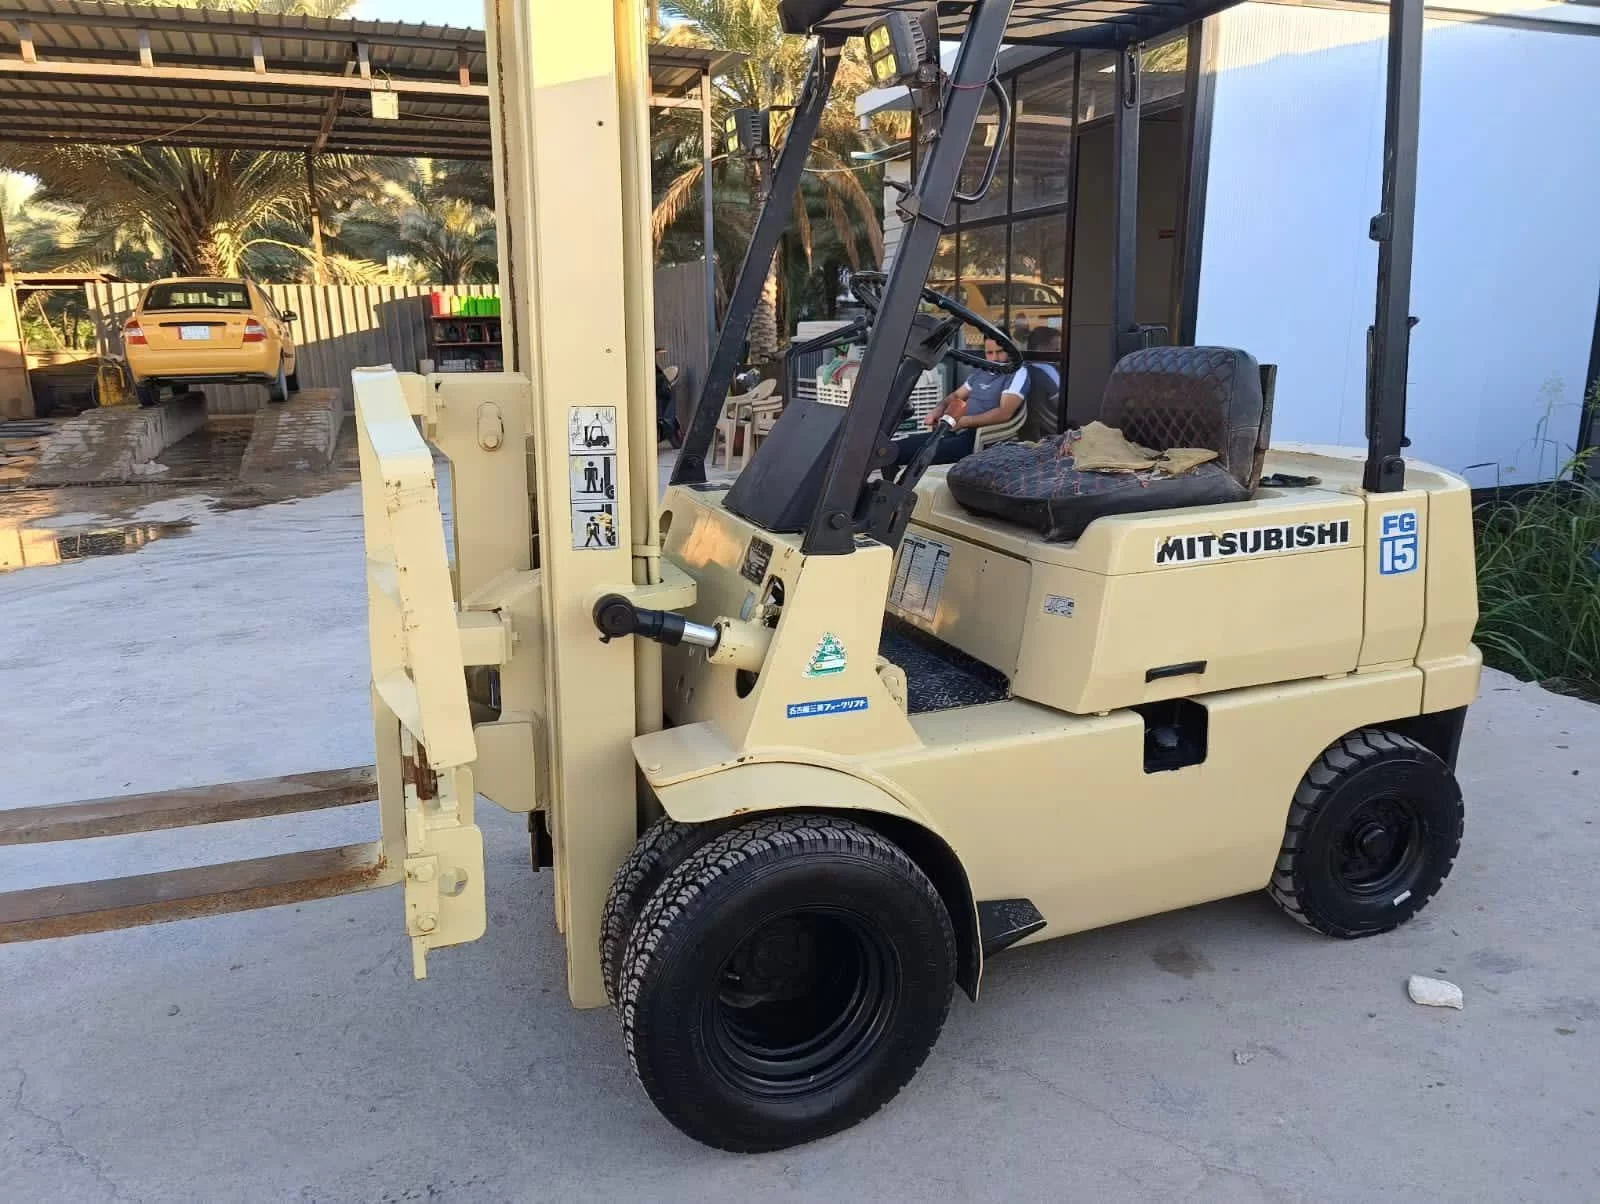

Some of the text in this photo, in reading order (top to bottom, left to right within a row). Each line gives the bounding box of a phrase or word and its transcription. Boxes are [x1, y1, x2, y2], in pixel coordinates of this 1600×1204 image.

[1384, 513, 1415, 534] FG
[1157, 521, 1348, 563] MITSUBISHI
[1383, 538, 1414, 572] 15
